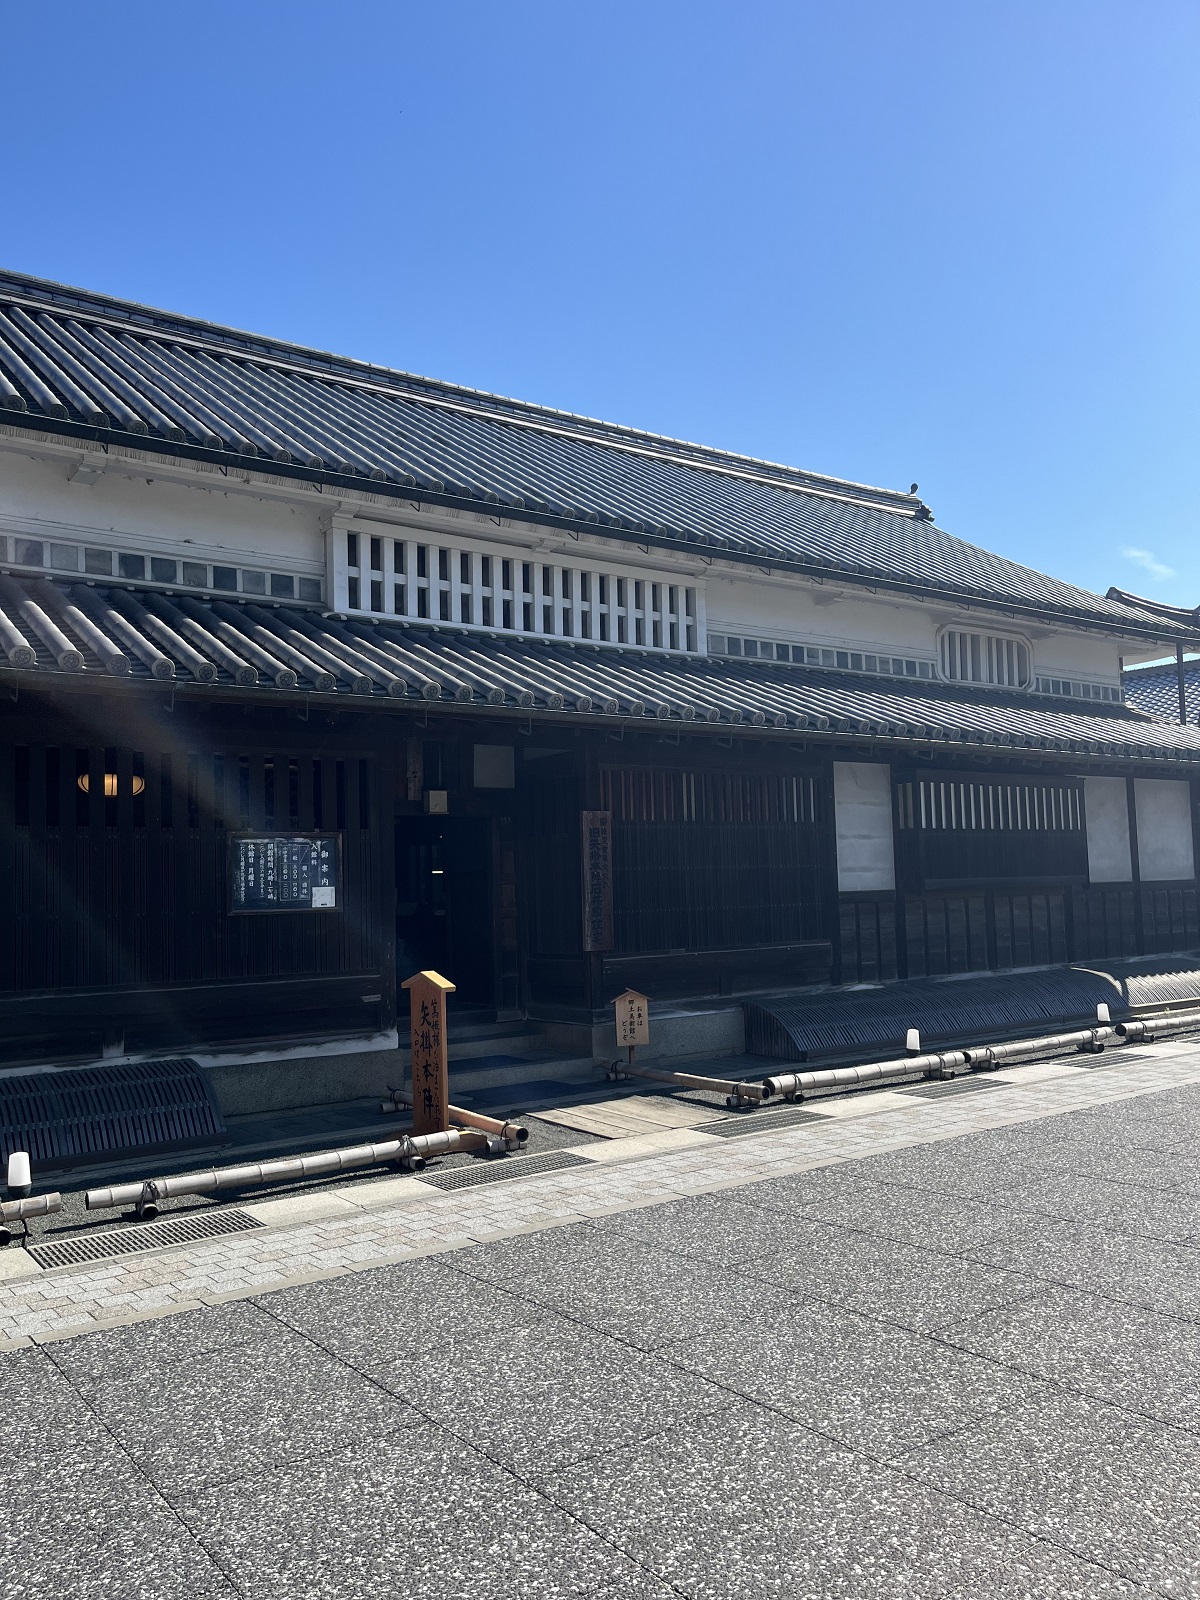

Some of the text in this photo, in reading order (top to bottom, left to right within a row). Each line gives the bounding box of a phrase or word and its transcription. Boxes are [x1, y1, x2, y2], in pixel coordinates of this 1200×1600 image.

[413, 1028, 422, 1098] 入口はこちら
[420, 1001, 434, 1119] 矢掛本陣
